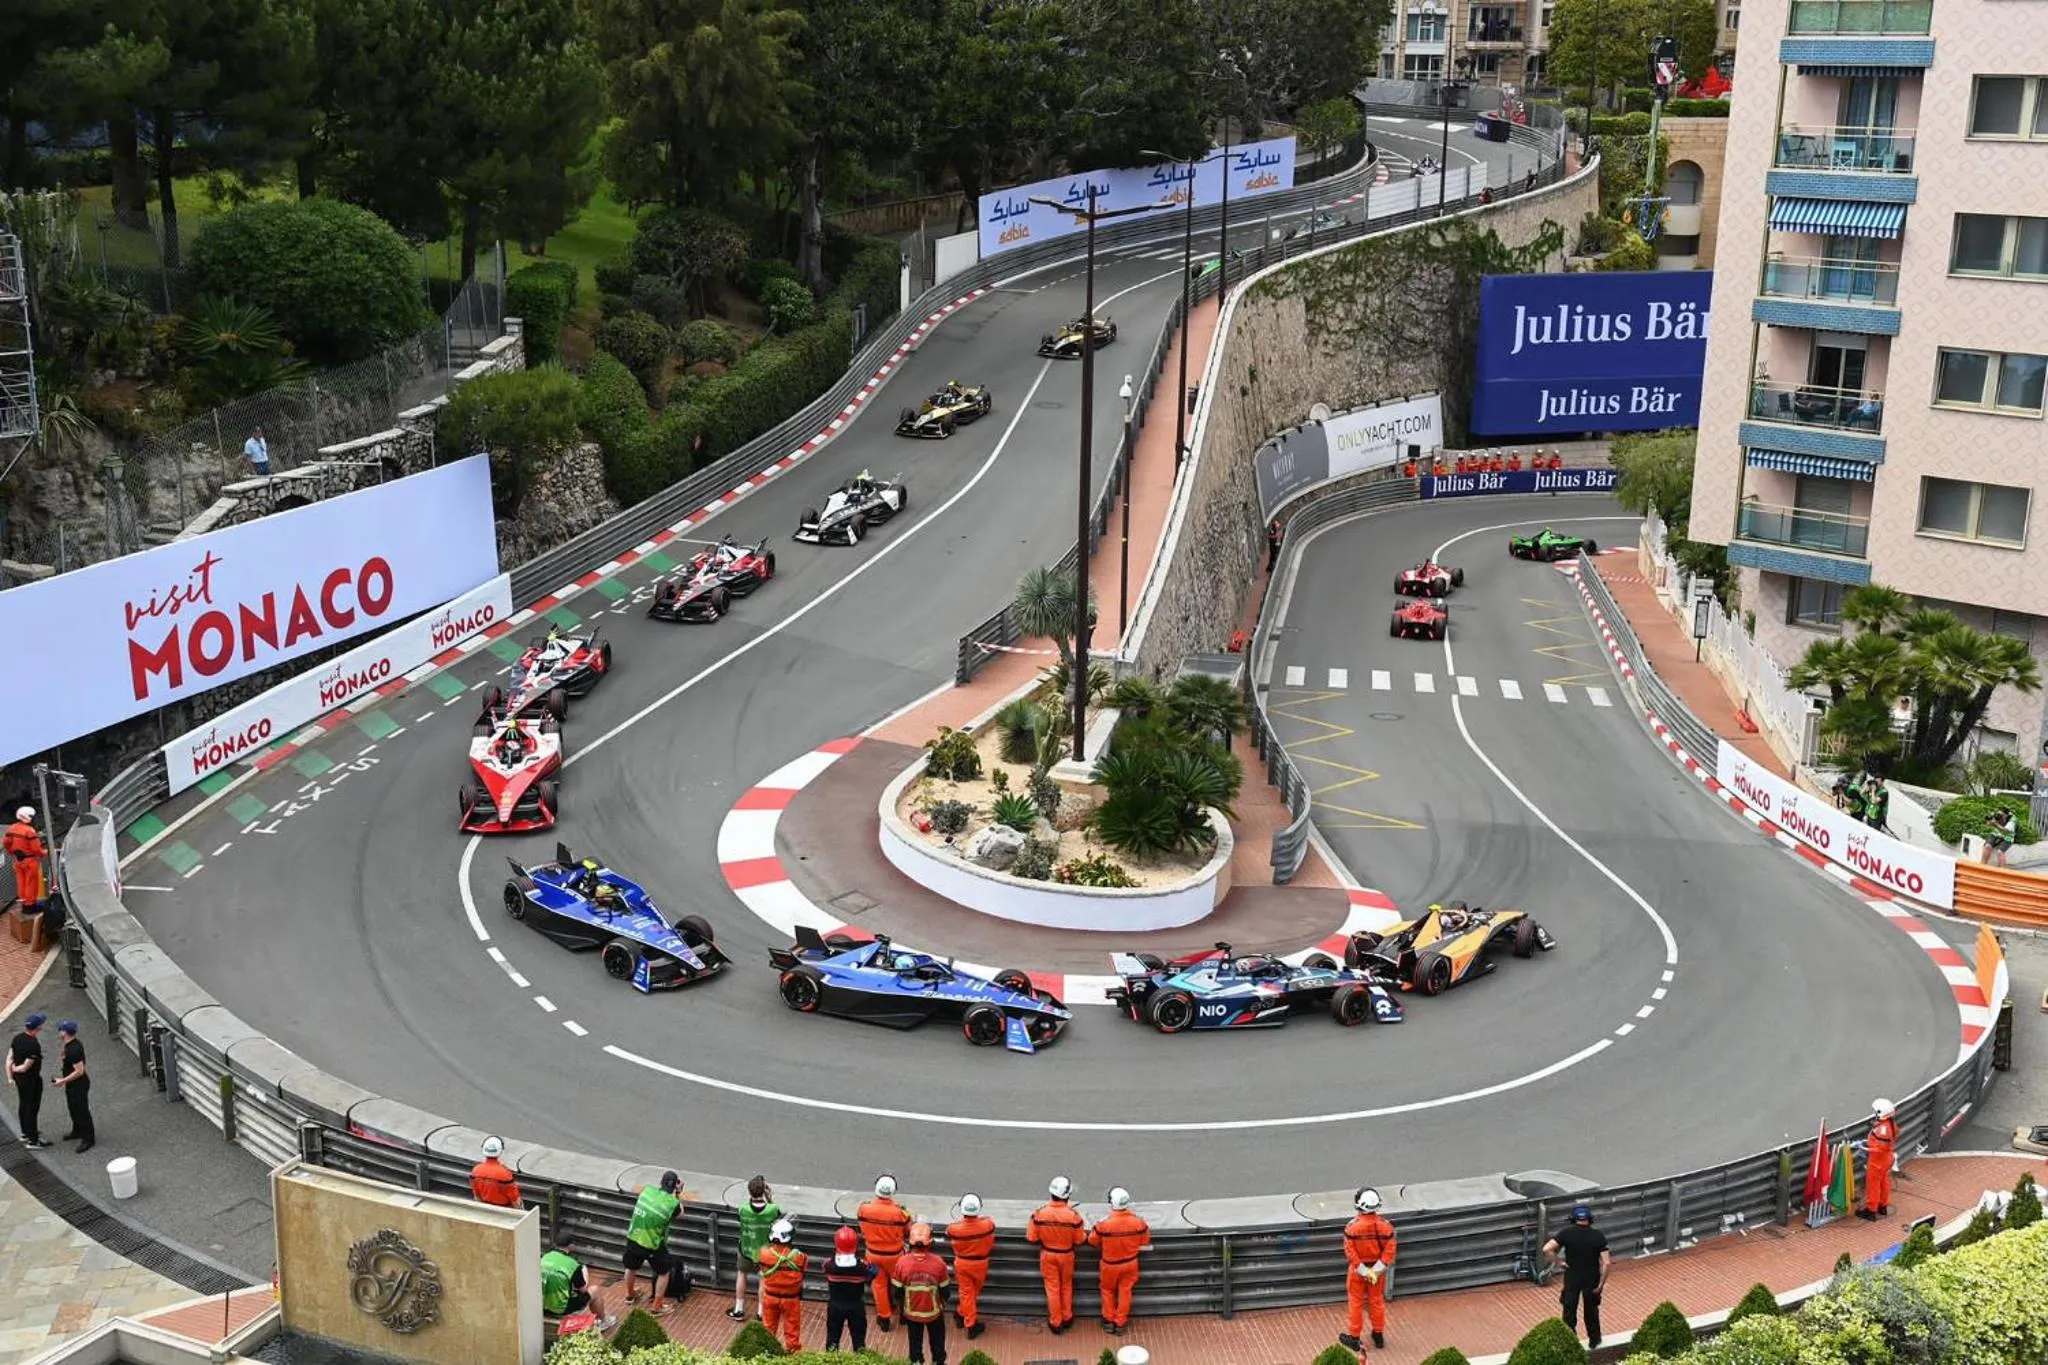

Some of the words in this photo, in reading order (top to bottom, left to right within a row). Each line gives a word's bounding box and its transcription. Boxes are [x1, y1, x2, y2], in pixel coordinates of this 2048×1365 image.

[1510, 304, 1632, 355] Julius
[1537, 388, 1621, 423] Julius
[1629, 387, 1682, 413] Bär
[1337, 413, 1432, 452] ONLYYACHT.COM
[1432, 474, 1474, 497] Julius
[1479, 472, 1508, 491] Bär
[1534, 471, 1581, 492] Julius
[1585, 469, 1617, 488] Bär
[124, 550, 223, 631] visit
[128, 556, 394, 701] MONACO
[432, 604, 494, 649] MONACO
[319, 658, 391, 707] MONACO
[192, 718, 272, 775] MONACO
[253, 757, 382, 834] TAXIS
[1734, 773, 1771, 811] MONACO
[1780, 808, 1830, 849] MONACO
[1846, 846, 1923, 894] MONACO
[1199, 1004, 1227, 1017] NIO
